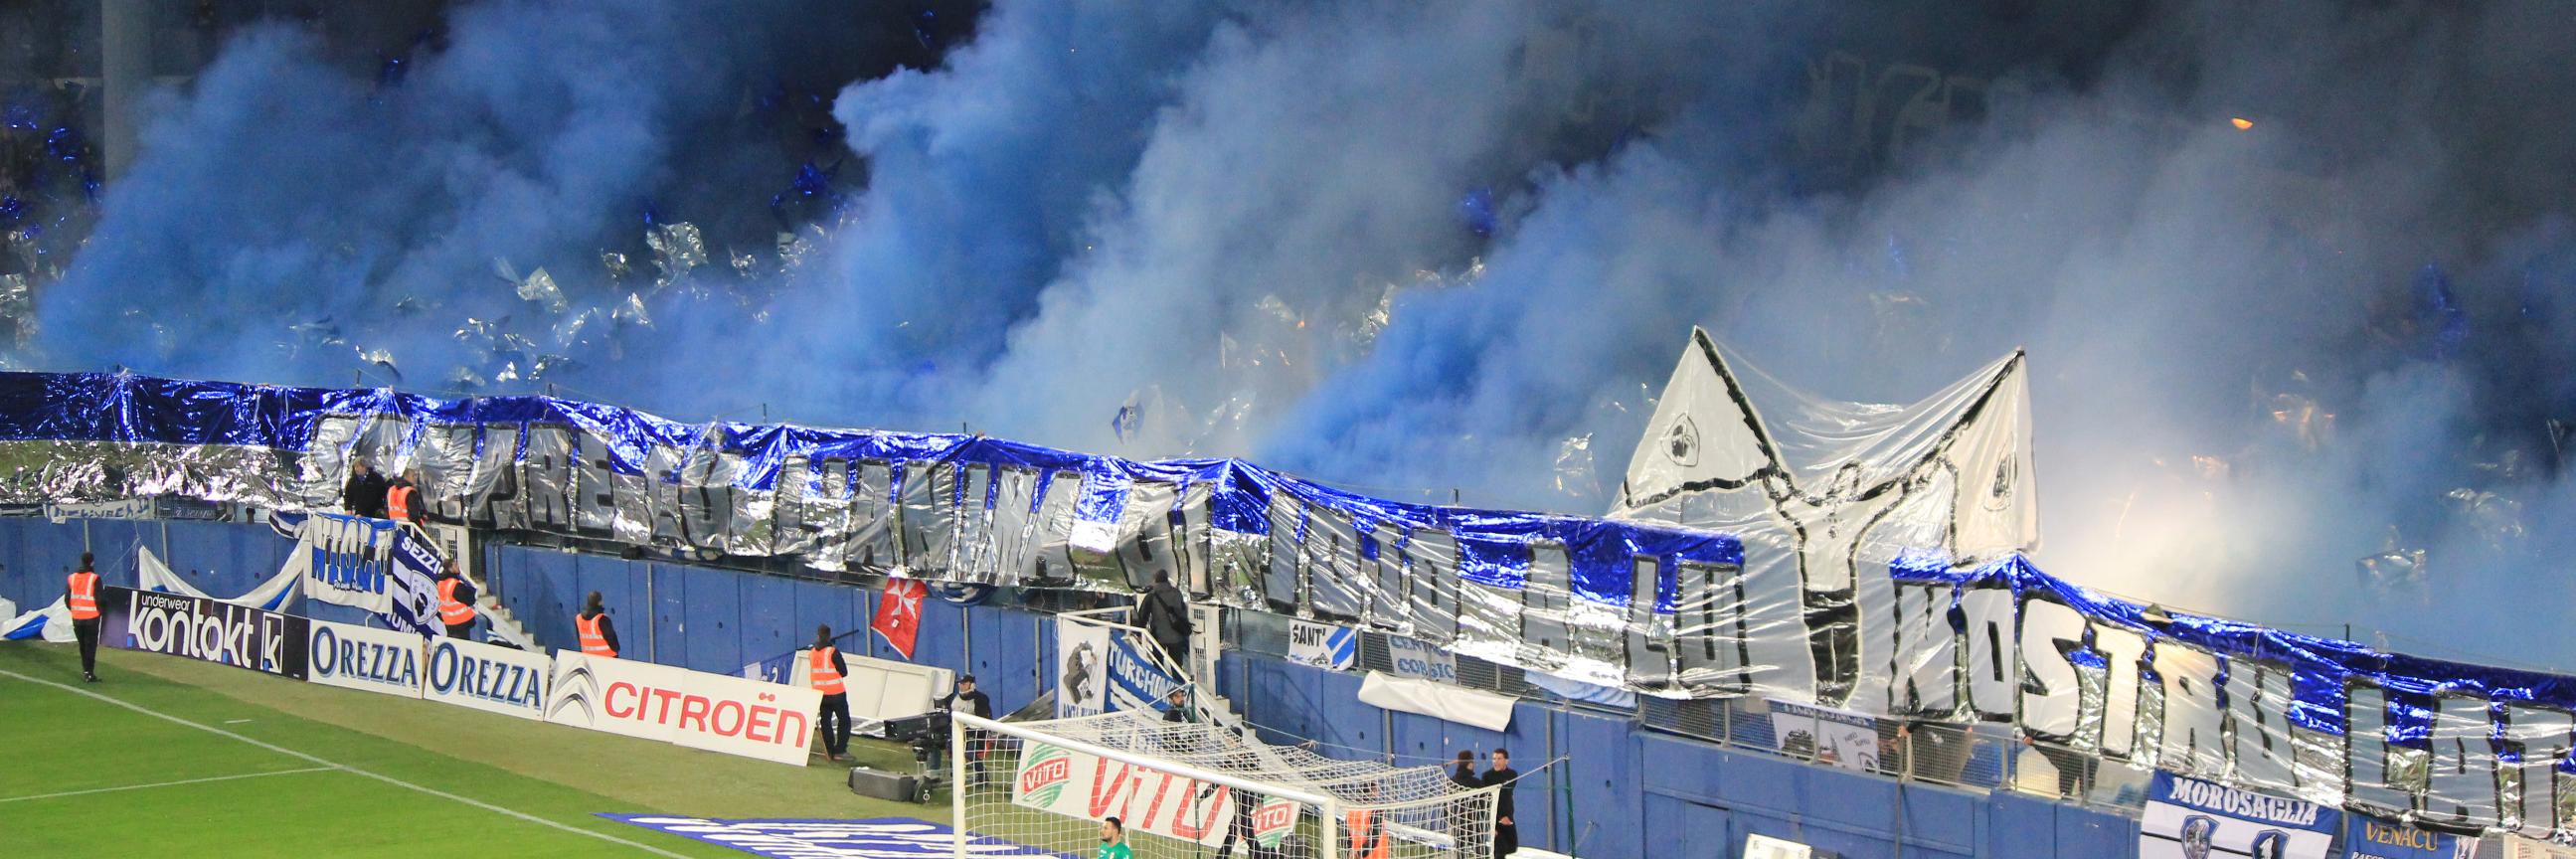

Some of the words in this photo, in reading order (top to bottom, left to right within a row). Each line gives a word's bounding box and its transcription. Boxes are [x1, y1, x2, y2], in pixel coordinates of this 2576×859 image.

[126, 590, 254, 669] kontakt
[141, 594, 191, 611] underwear
[1519, 539, 1574, 660] A
[1624, 554, 1751, 695] LU
[311, 625, 420, 689] OREZZA
[1292, 623, 1327, 647] SANT'
[429, 641, 543, 711] OREZZA
[1109, 639, 1175, 705] TURCHIN
[2168, 776, 2320, 826] MOROSAGLIA
[2366, 821, 2439, 852] VENACU
